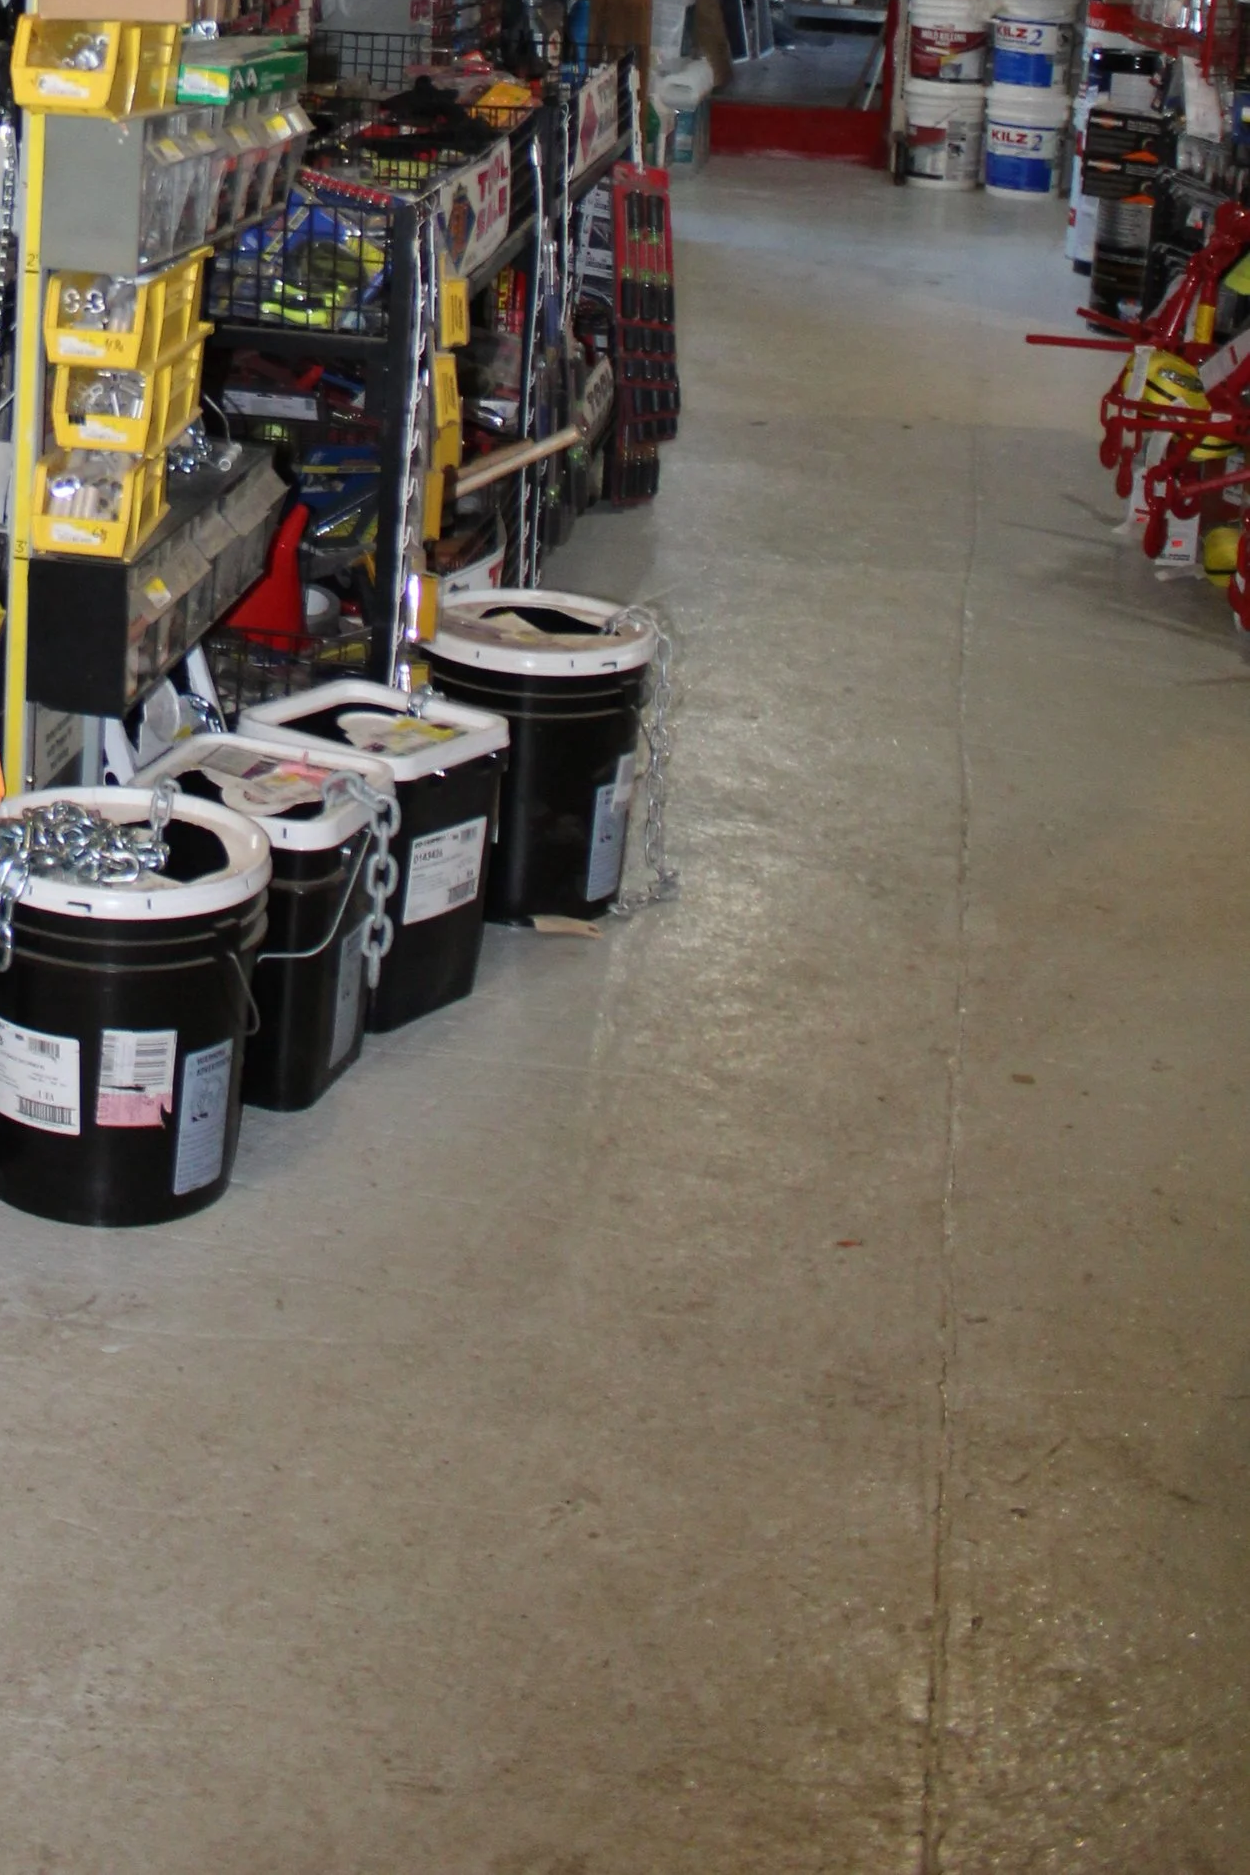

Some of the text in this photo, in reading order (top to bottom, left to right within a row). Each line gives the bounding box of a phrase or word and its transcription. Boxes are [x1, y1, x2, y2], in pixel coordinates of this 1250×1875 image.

[997, 24, 1043, 46] KILZ 2
[991, 129, 1043, 151] KILZ 2
